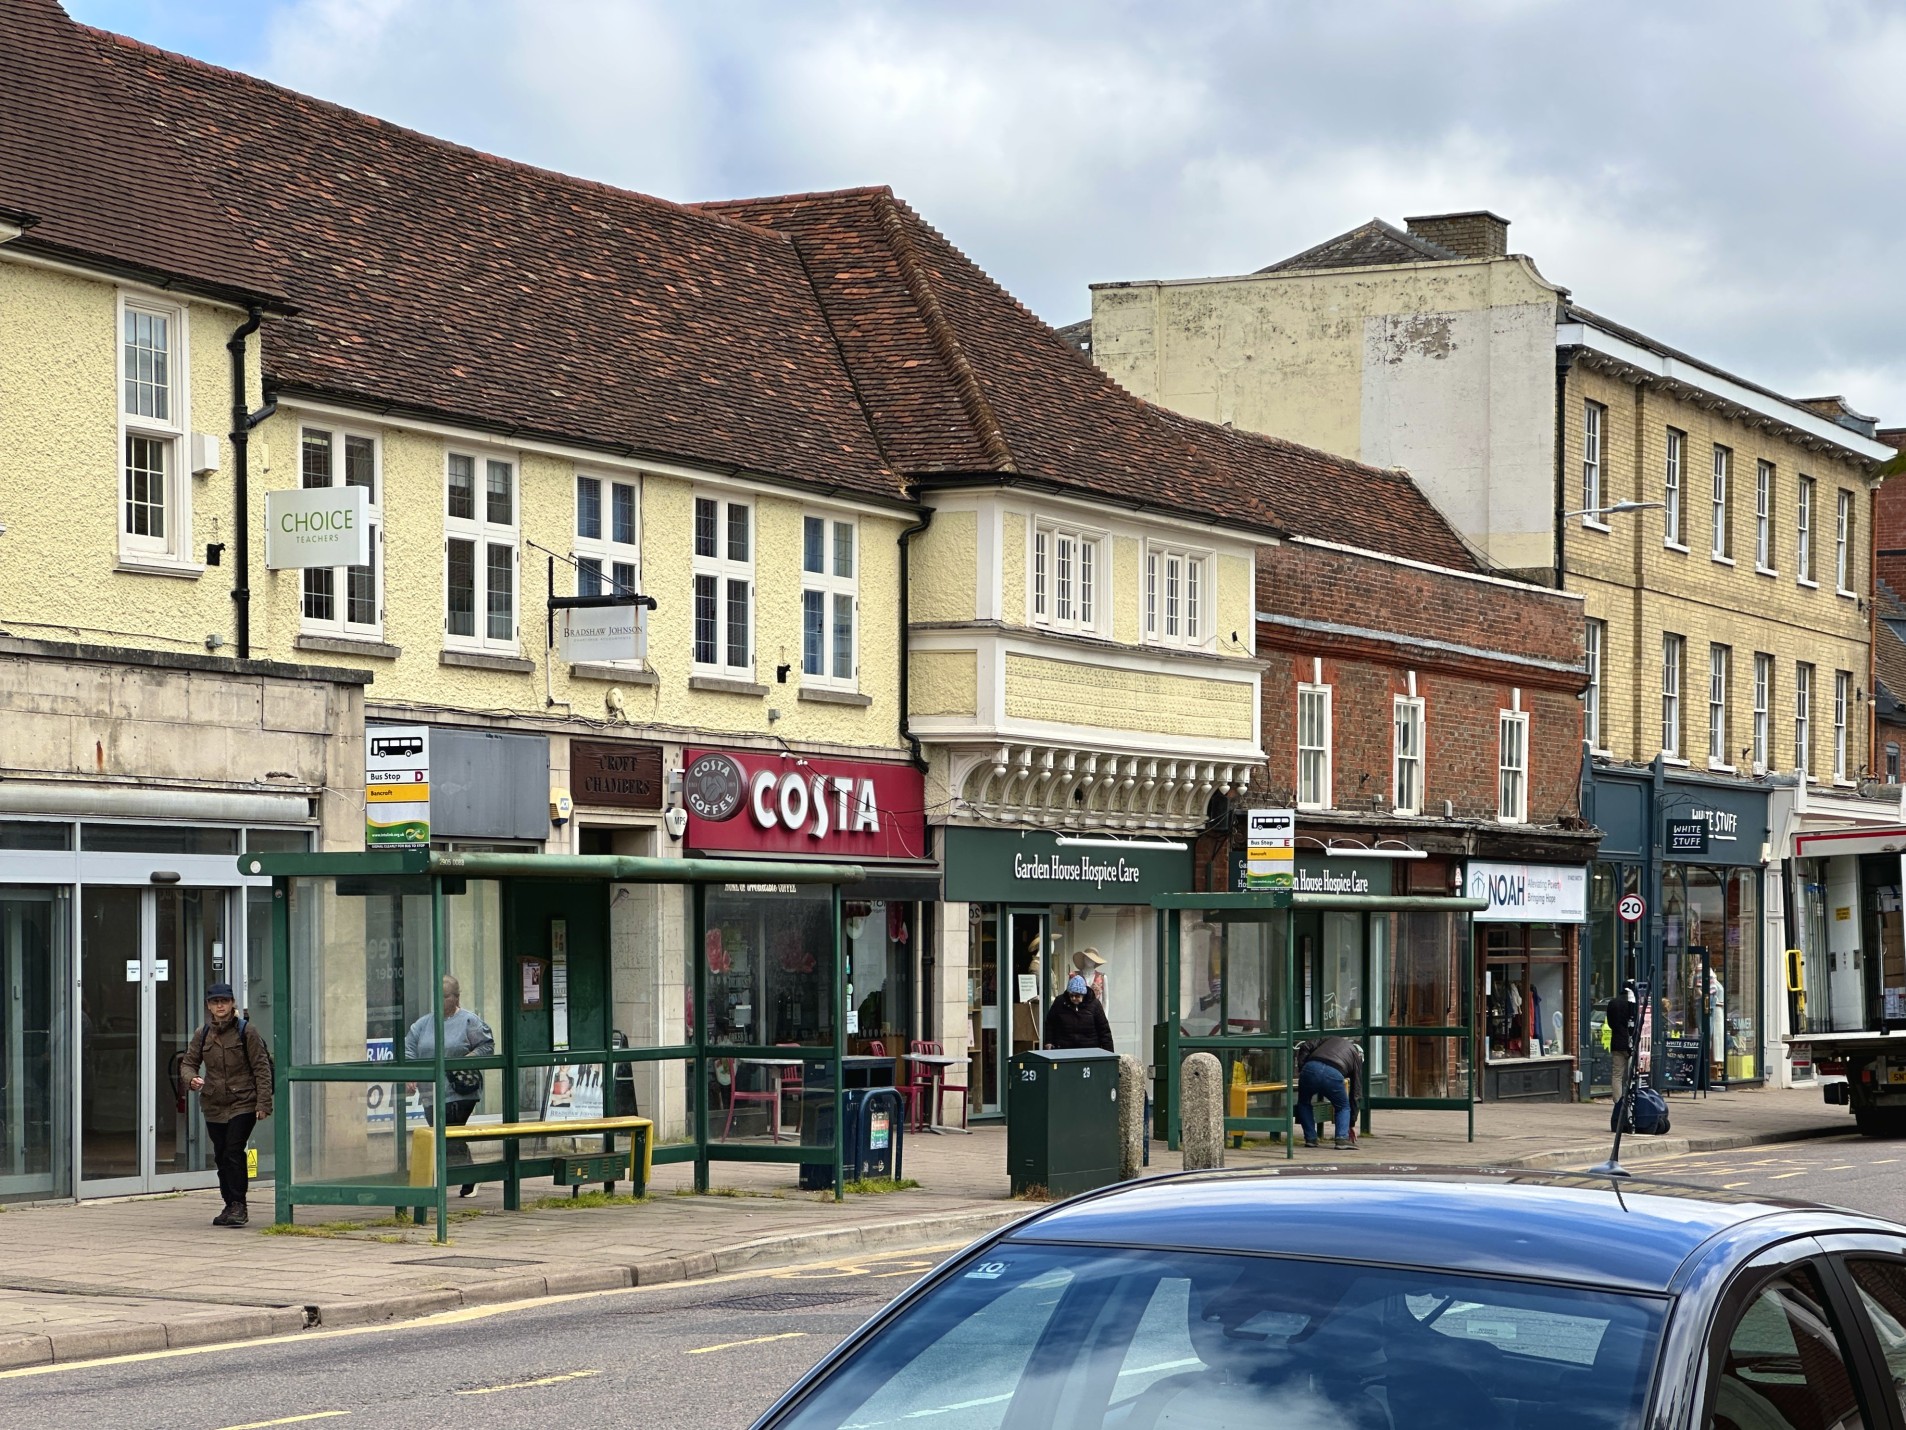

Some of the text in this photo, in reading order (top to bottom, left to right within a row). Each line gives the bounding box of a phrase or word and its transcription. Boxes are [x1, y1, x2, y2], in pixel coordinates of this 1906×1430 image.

[281, 509, 353, 533] CHOICE
[296, 534, 339, 544] TEACHERS
[564, 626, 643, 638] BRADSHAW JOHNSON
[599, 755, 638, 772] CROFT
[693, 760, 731, 777] COSTA
[384, 773, 401, 781] Stop
[415, 771, 424, 781] D
[584, 776, 651, 796] CHAMBERS
[690, 793, 735, 814] COFFEE
[750, 770, 880, 839] COSTA
[674, 816, 686, 826] MPS
[1715, 811, 1737, 833] STUFF
[1673, 825, 1701, 833] WHITE
[1673, 837, 1701, 846] STUFF
[1015, 853, 1139, 889] Garden House Hospice Care
[1300, 869, 1323, 891] House
[1323, 869, 1351, 894] Hospice
[1352, 870, 1368, 892] Care
[1488, 874, 1525, 906] NOAH
[1546, 894, 1556, 904] Hope
[1621, 902, 1641, 914] 20
[1021, 1070, 1037, 1081] 29
[1083, 1067, 1091, 1078] 29
[977, 1262, 1004, 1273] 10
